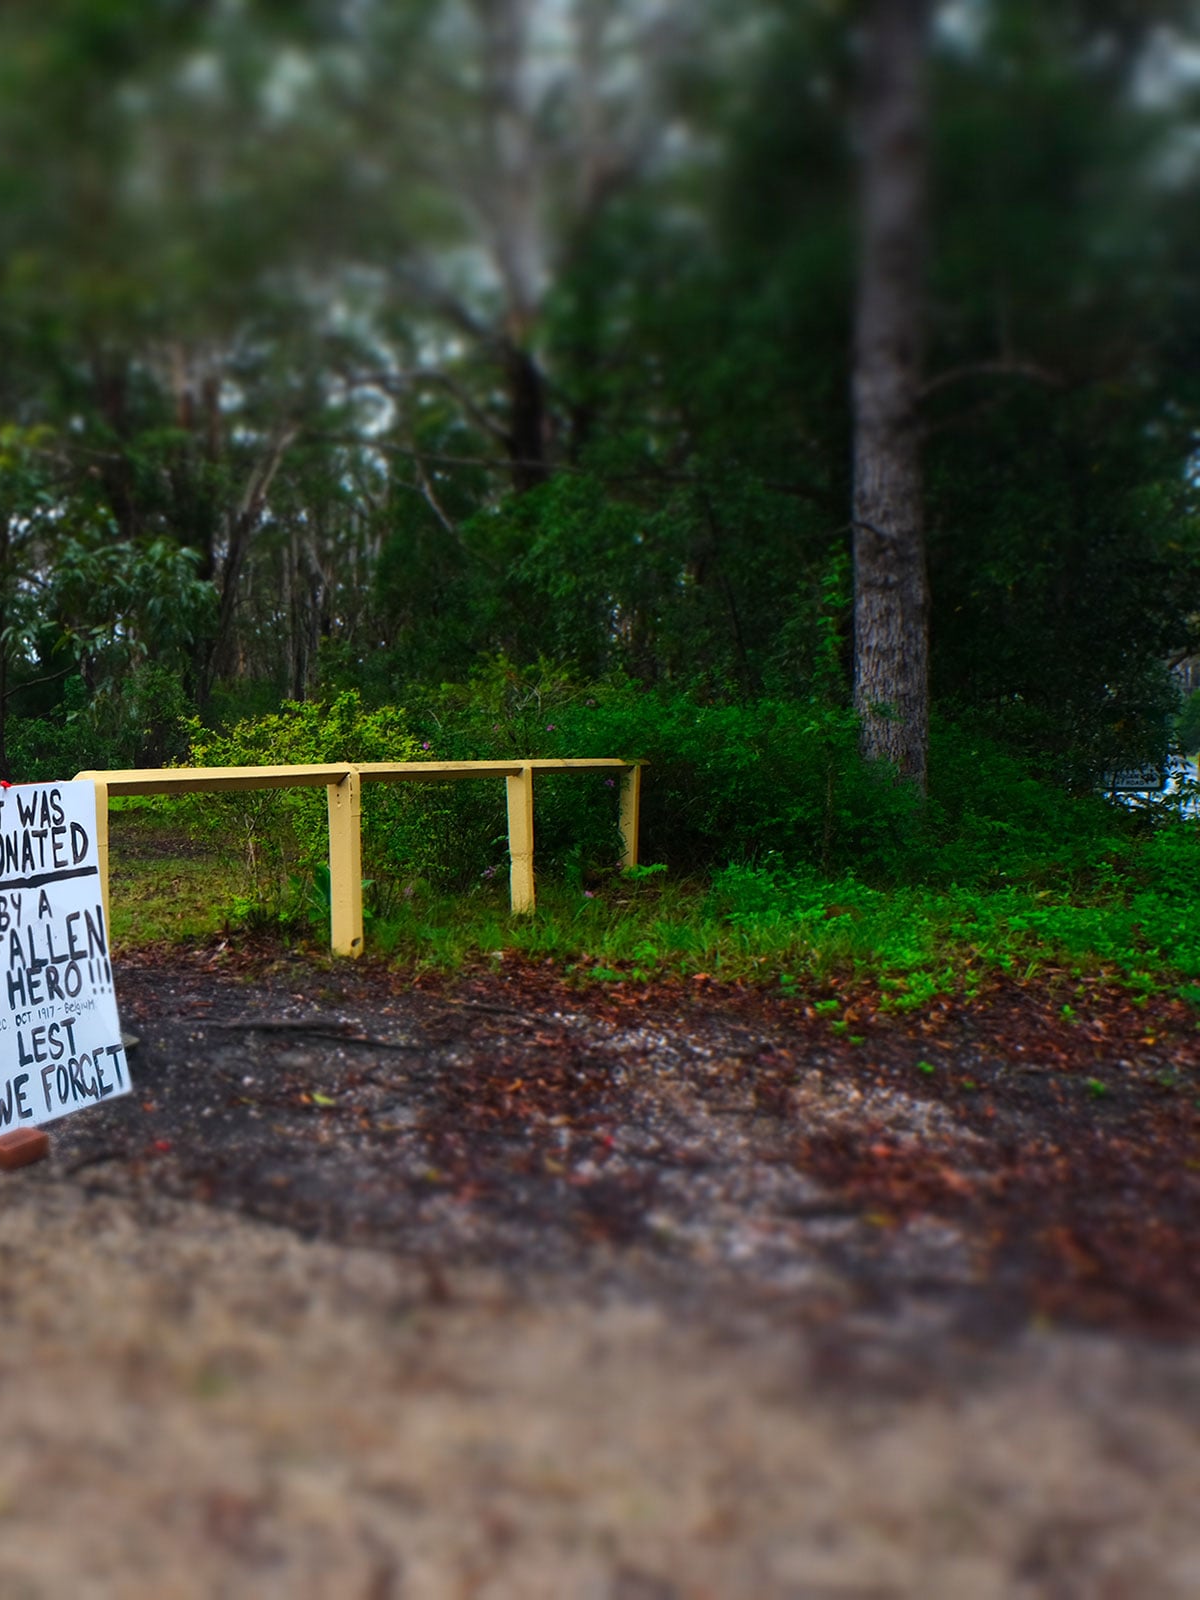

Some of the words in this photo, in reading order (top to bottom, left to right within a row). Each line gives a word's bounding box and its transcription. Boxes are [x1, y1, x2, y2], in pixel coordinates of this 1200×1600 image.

[16, 789, 65, 828] WAS
[39, 889, 53, 920] A
[38, 1005, 55, 1020] 1917
[17, 1017, 77, 1067] LEST
[40, 1043, 123, 1113] FORGET
